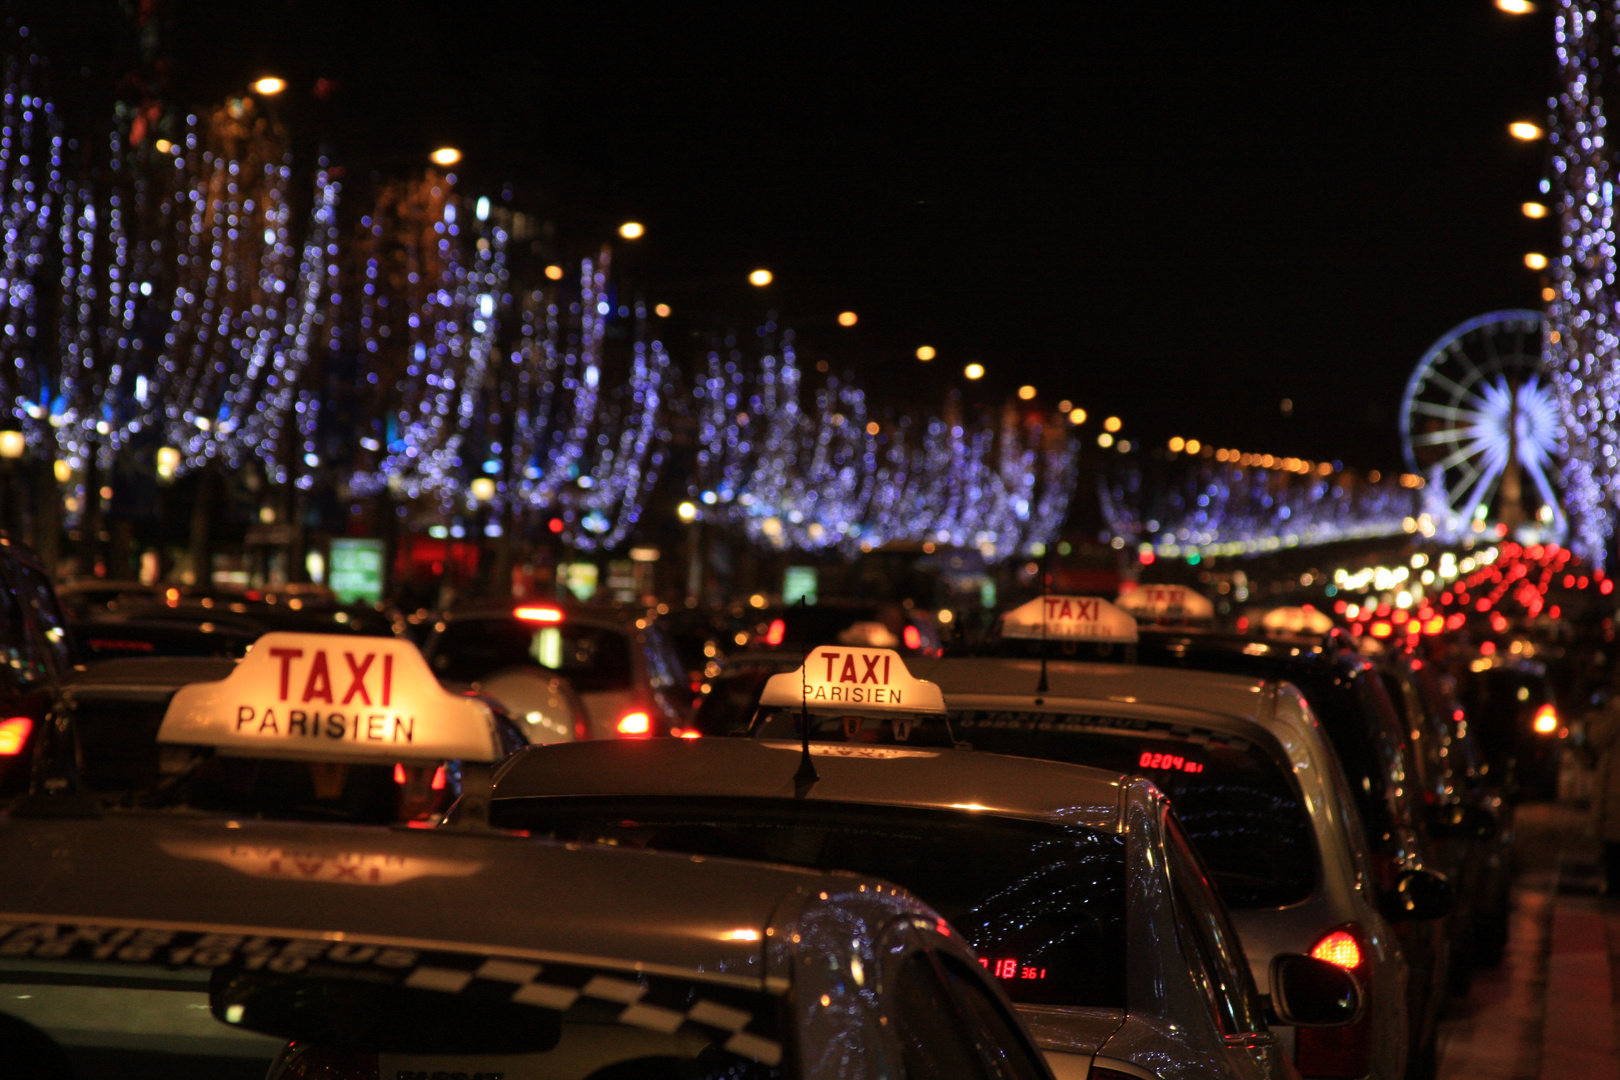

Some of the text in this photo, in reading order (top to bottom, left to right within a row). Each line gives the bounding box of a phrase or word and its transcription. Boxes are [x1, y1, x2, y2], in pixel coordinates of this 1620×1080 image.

[1044, 599, 1099, 621] TAXI
[269, 647, 393, 706] TAXI
[821, 652, 890, 685] TAXI
[803, 684, 902, 704] PARISIEN
[236, 706, 414, 742] PARISIEN
[1139, 752, 1184, 770] 0204
[1021, 967, 1046, 979] 361
